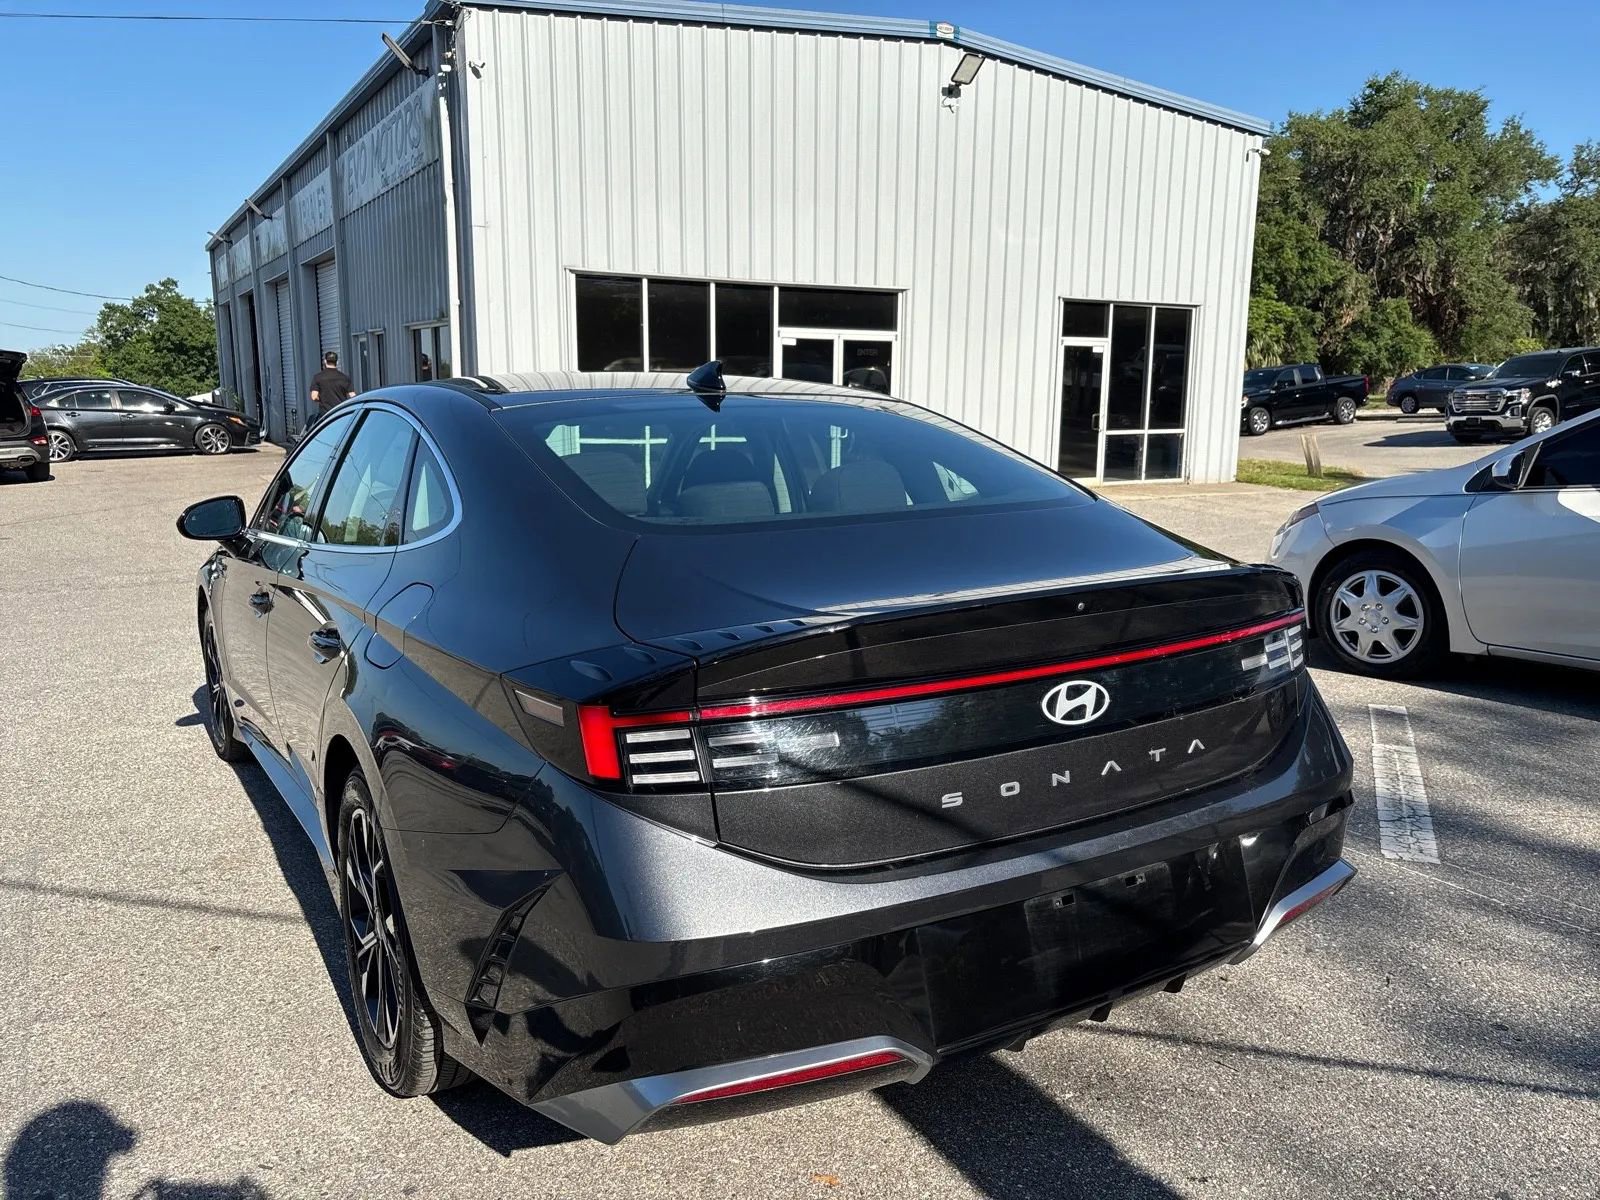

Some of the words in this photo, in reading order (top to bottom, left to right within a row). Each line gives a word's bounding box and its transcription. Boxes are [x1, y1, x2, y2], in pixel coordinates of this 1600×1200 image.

[347, 139, 368, 196] EVO
[370, 94, 422, 179] MOTORS
[941, 738, 1205, 808] SONATA
